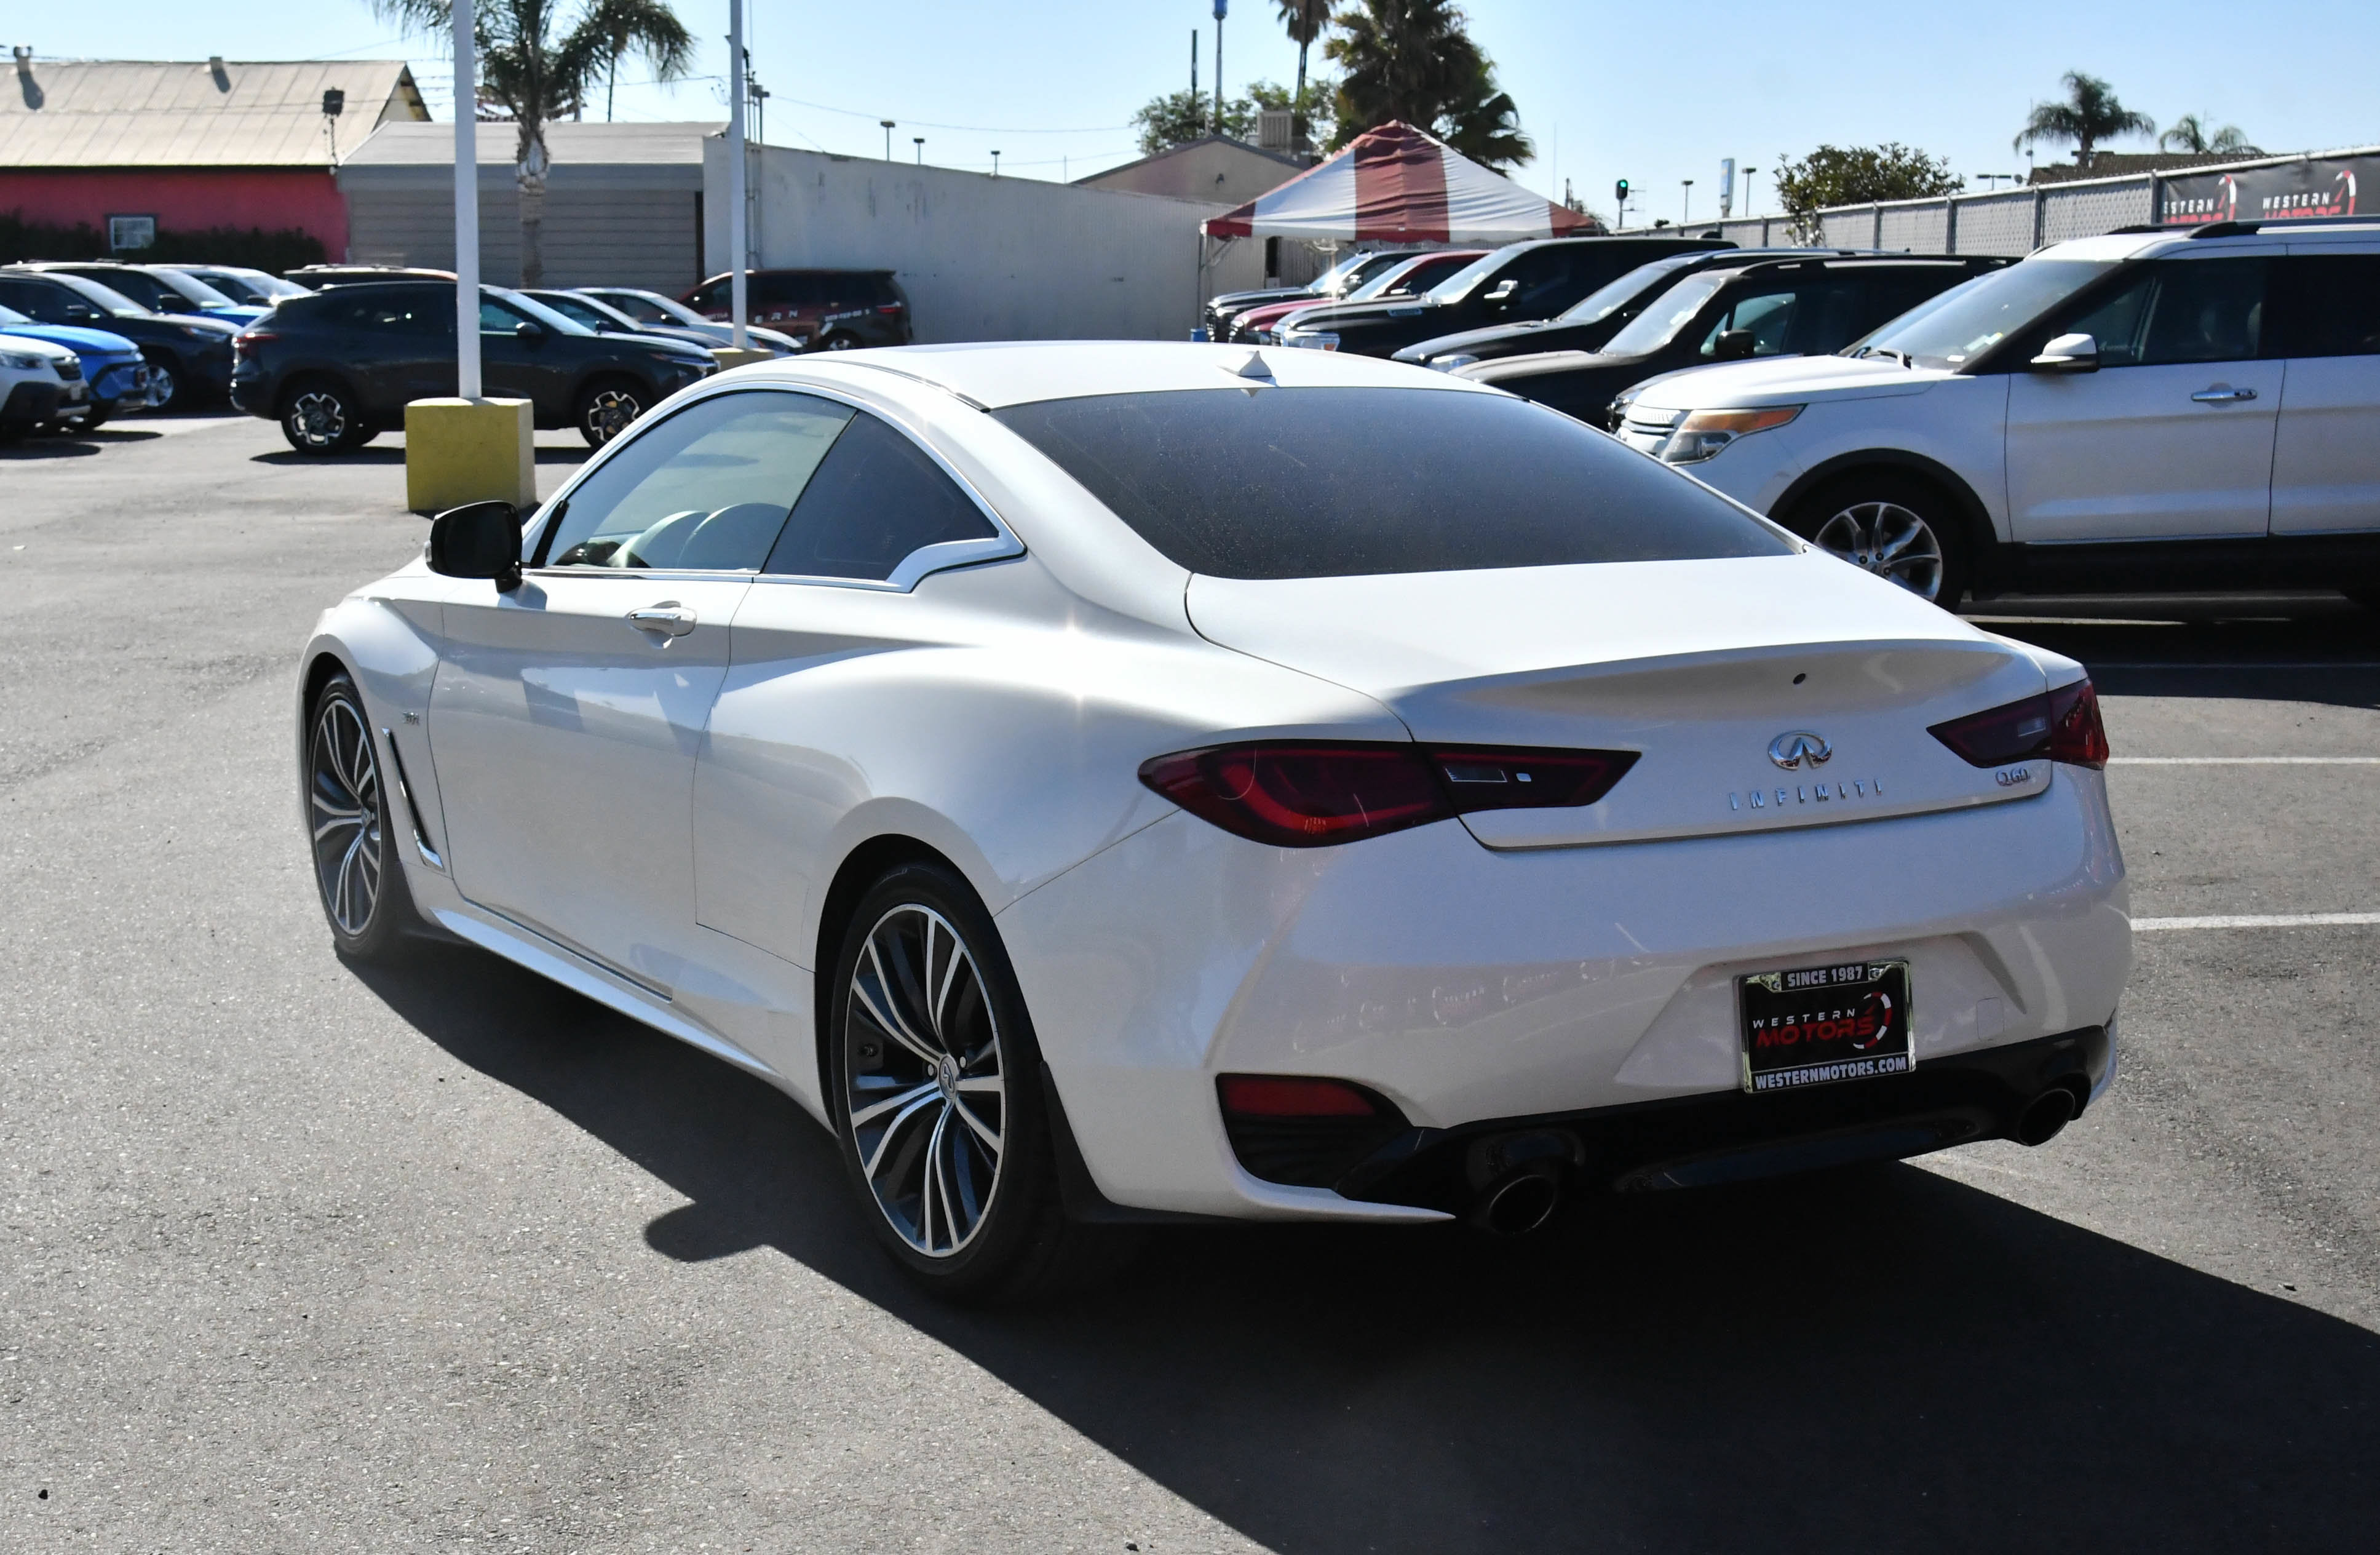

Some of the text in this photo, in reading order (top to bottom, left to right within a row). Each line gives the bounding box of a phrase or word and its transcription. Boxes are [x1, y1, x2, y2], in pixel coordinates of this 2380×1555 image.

[2164, 198, 2213, 214] ESTERN
[2263, 192, 2330, 209] WESTERN
[1995, 767, 2030, 787] Q60
[1729, 778, 1882, 811] INFINITI
[1787, 966, 1863, 987] SINCE 1987
[1753, 1008, 1855, 1029] WESTERN
[1756, 1016, 1875, 1048] MOTORS
[1755, 1056, 1907, 1089] WESTERNMOTORS.COM
